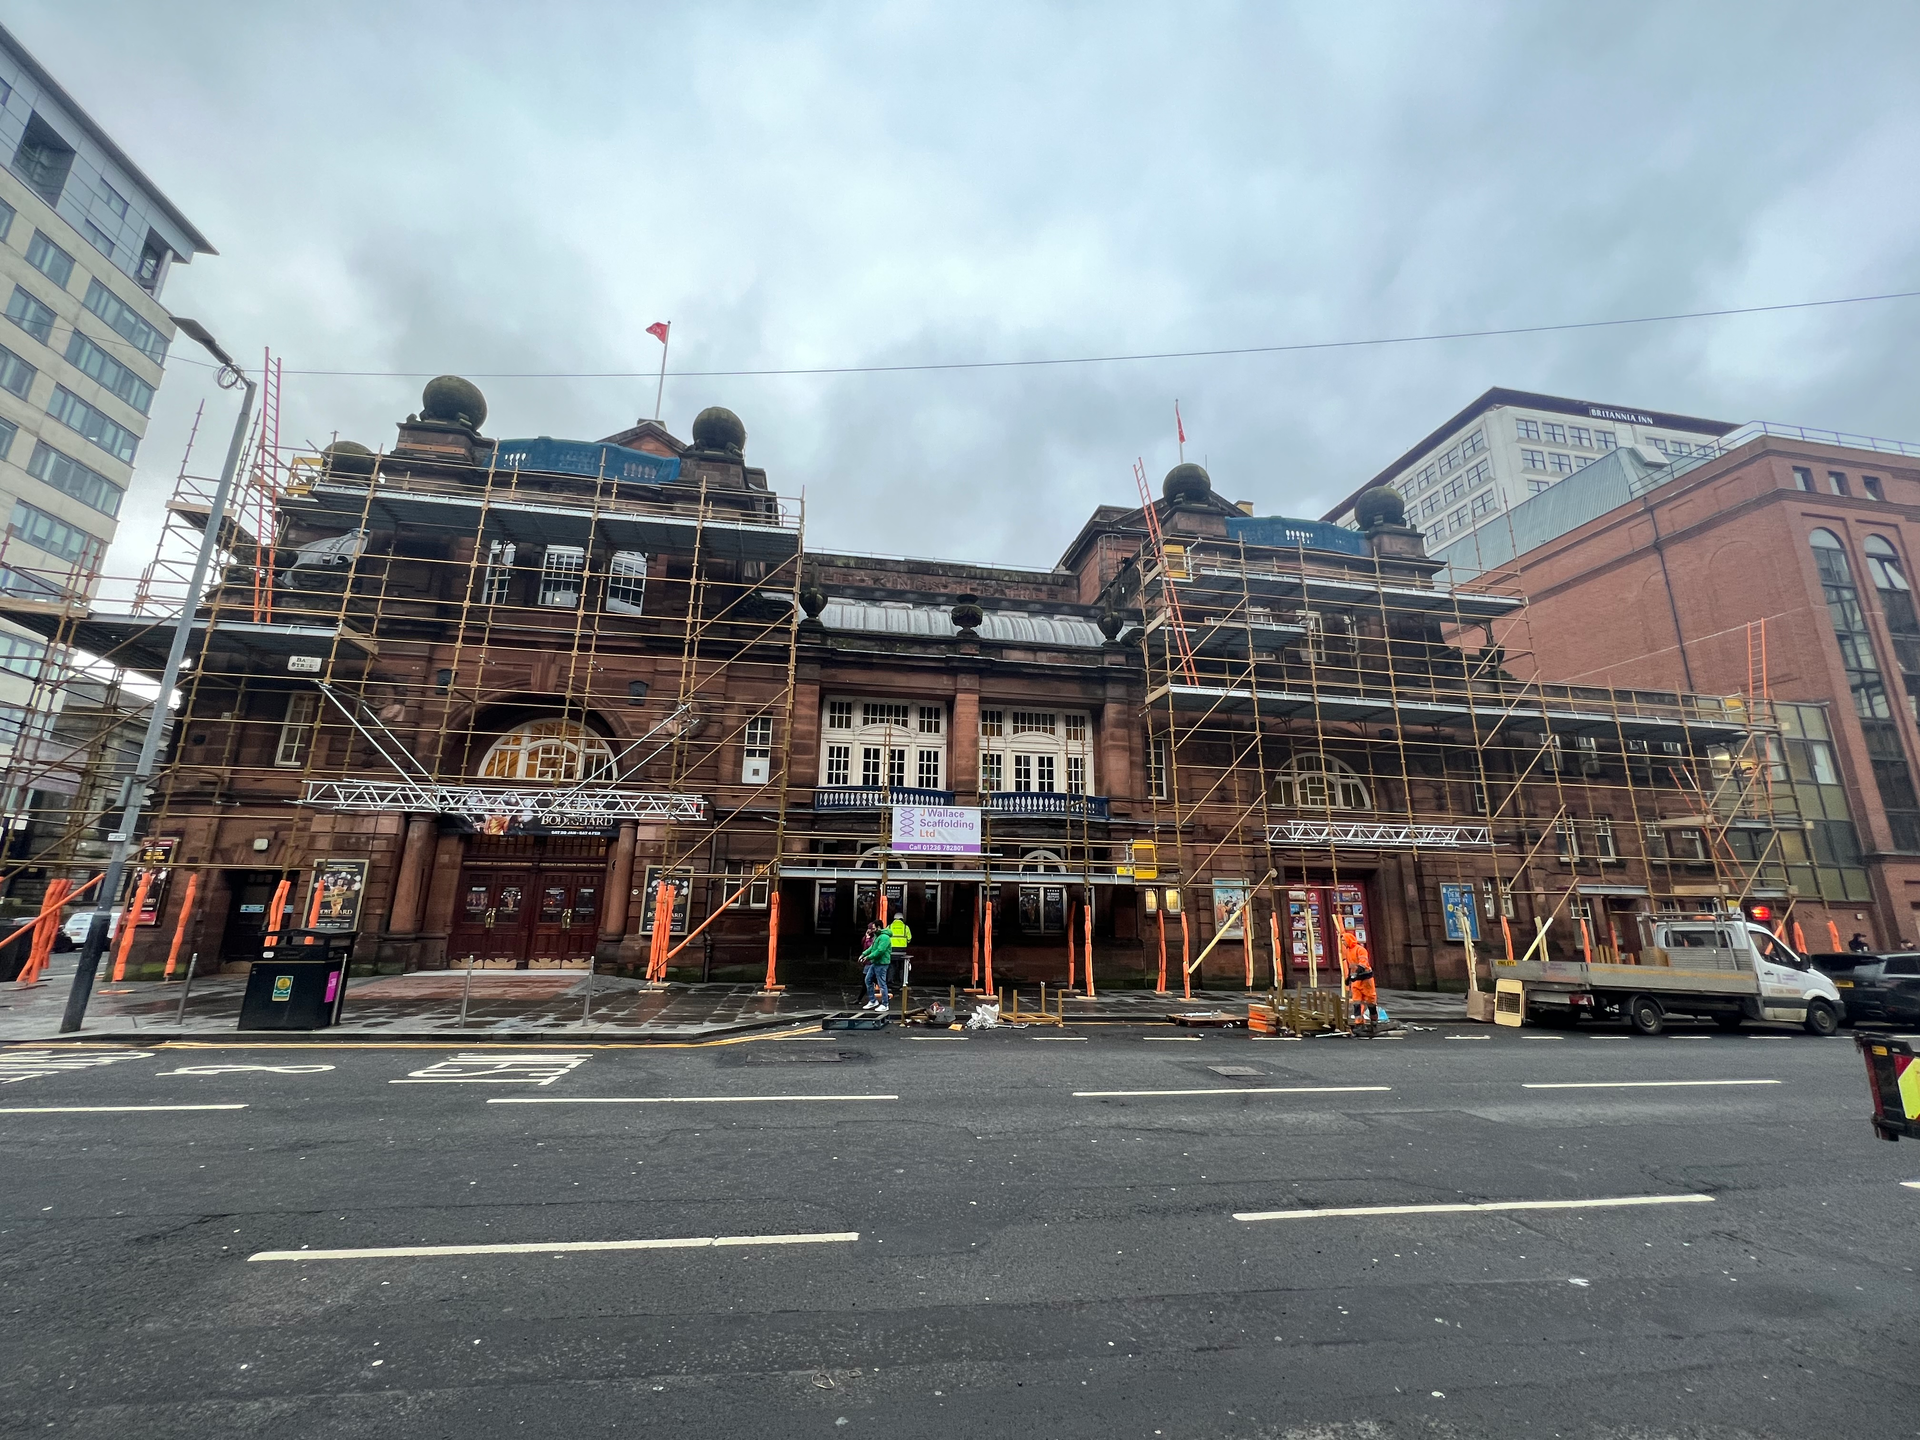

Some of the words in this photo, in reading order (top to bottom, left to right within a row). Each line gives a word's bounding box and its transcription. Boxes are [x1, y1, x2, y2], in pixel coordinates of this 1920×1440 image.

[1591, 409, 1636, 422] BRITANNIA
[1636, 415, 1653, 424] INN
[920, 808, 926, 817] J
[927, 808, 965, 818] Wallace
[541, 815, 614, 826] BODGUARD
[919, 818, 974, 830] Scaffolding
[919, 829, 936, 837] Ltd
[908, 843, 922, 851] Call
